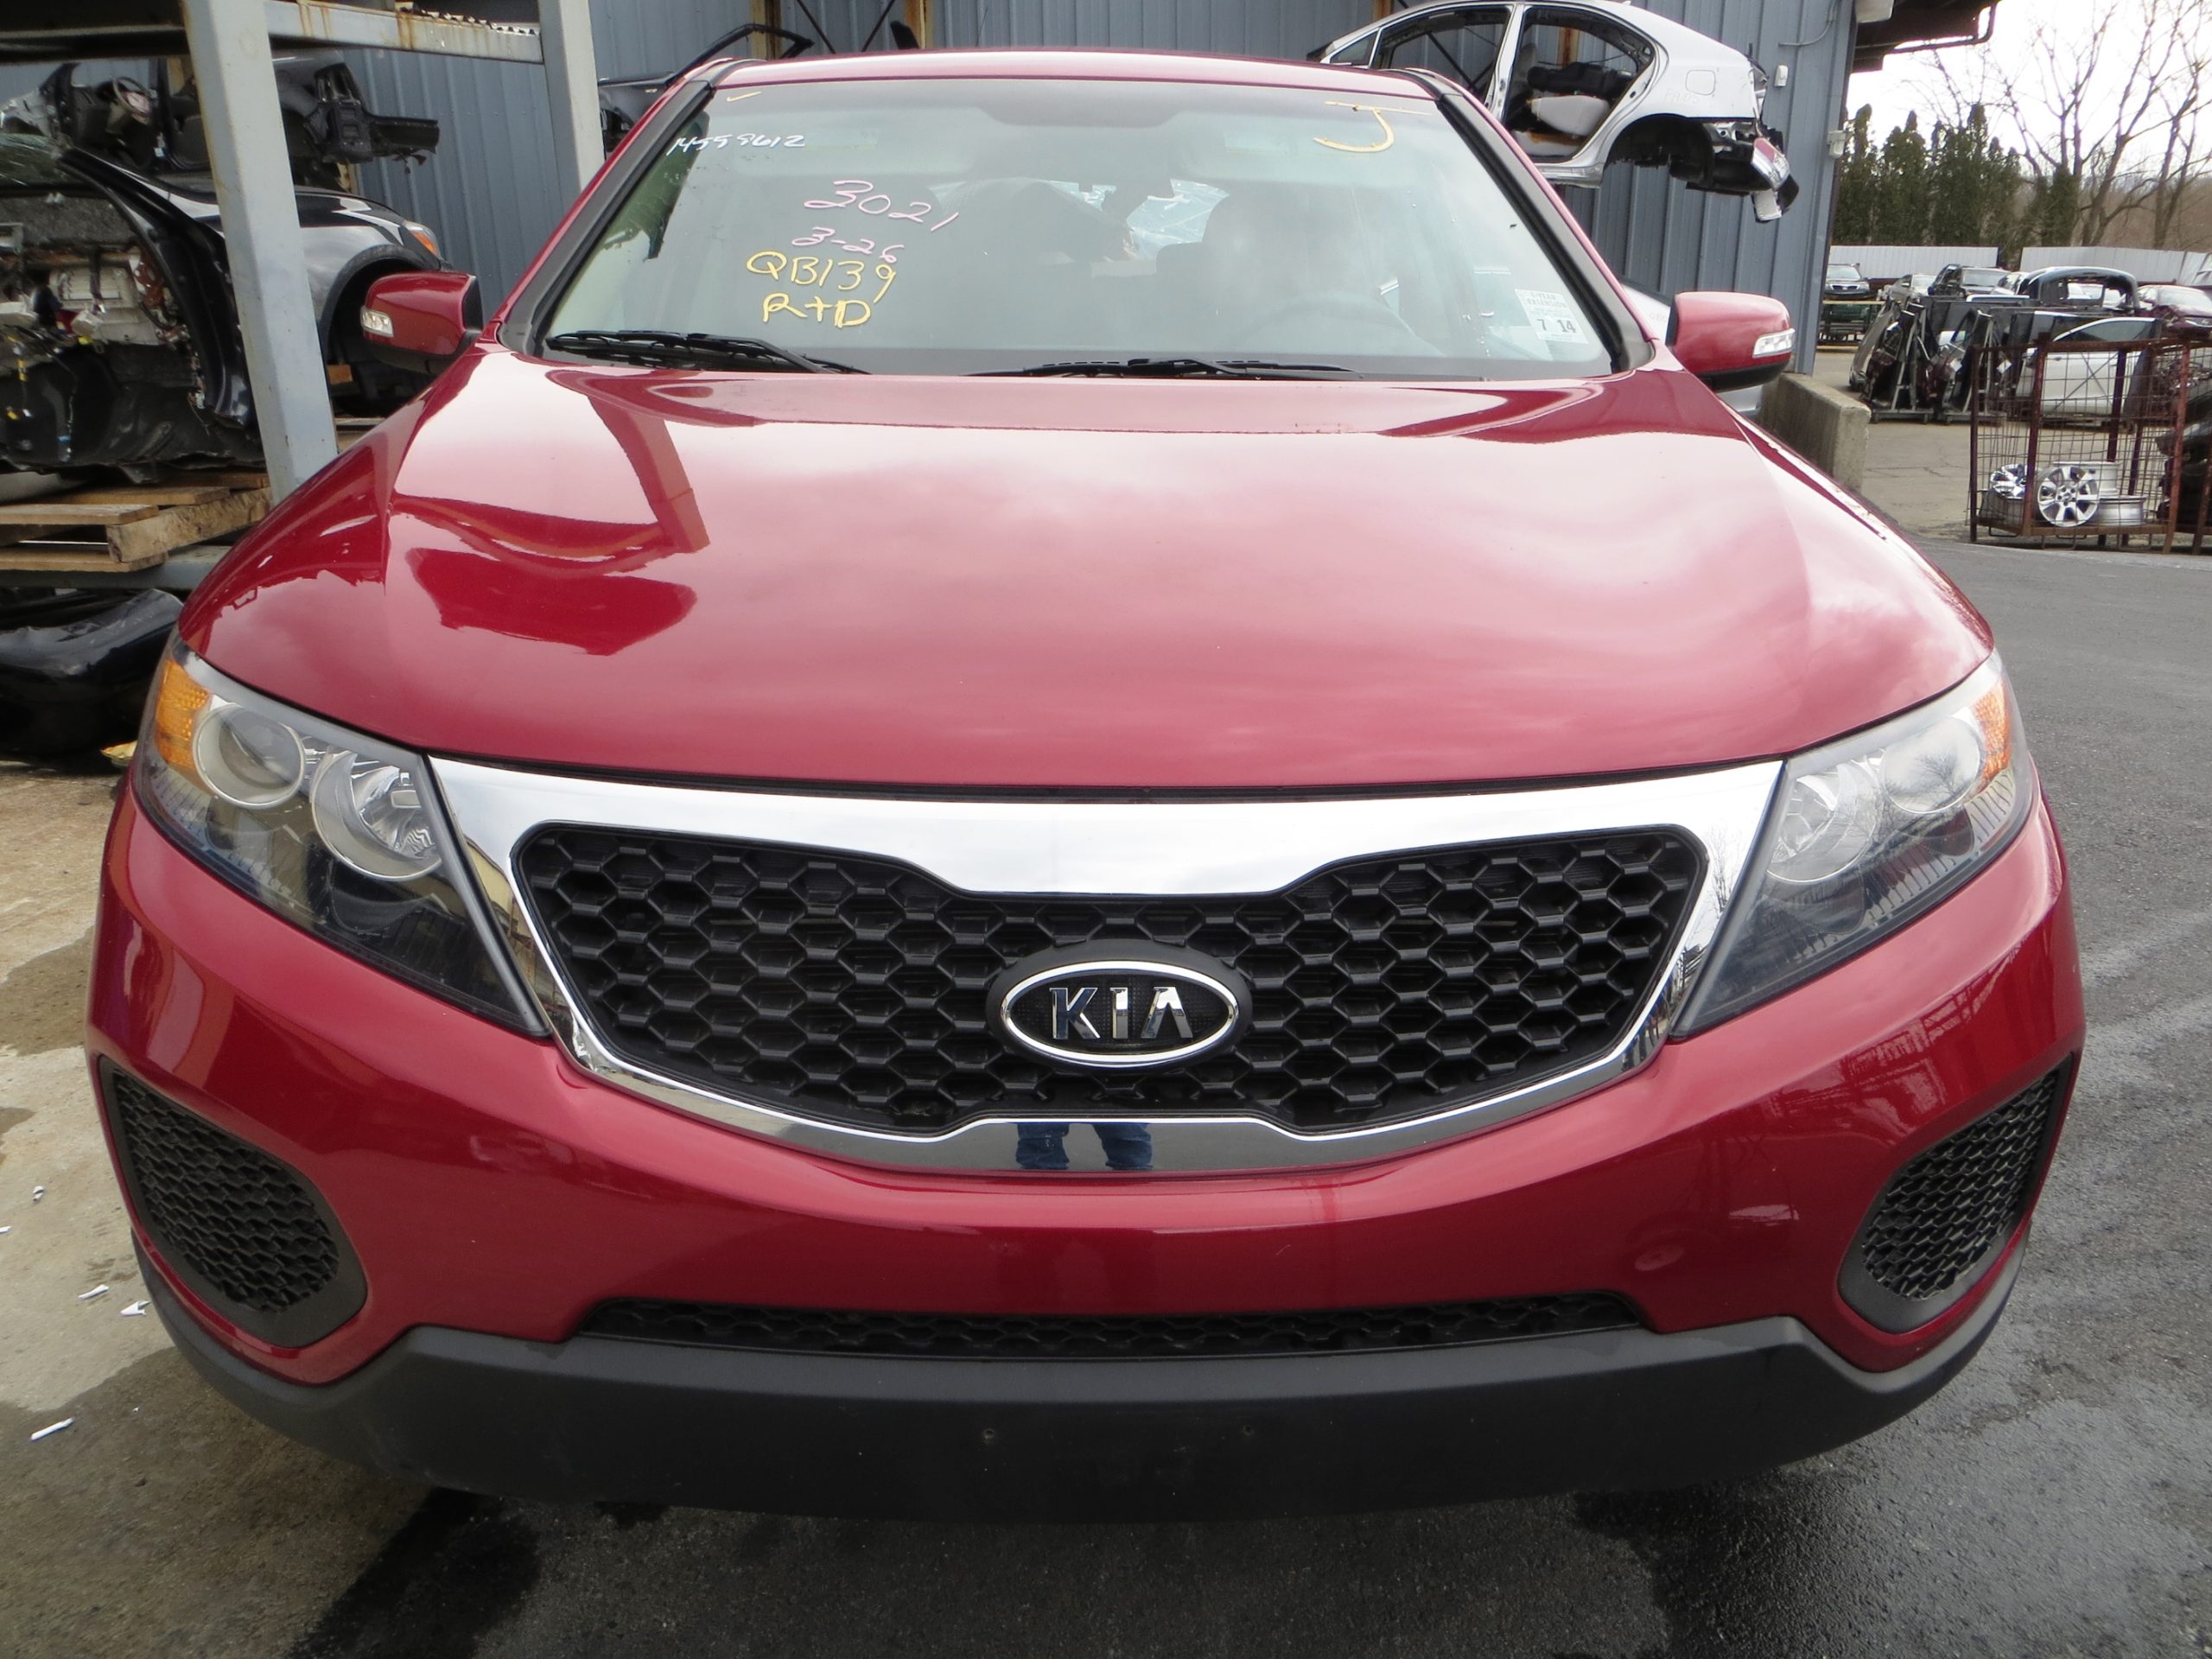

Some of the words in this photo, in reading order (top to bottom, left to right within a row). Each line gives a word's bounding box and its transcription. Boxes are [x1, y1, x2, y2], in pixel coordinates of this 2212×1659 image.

[1536, 318, 1547, 331] 7
[1557, 319, 1577, 334] 14
[1049, 986, 1193, 1039] KIA
